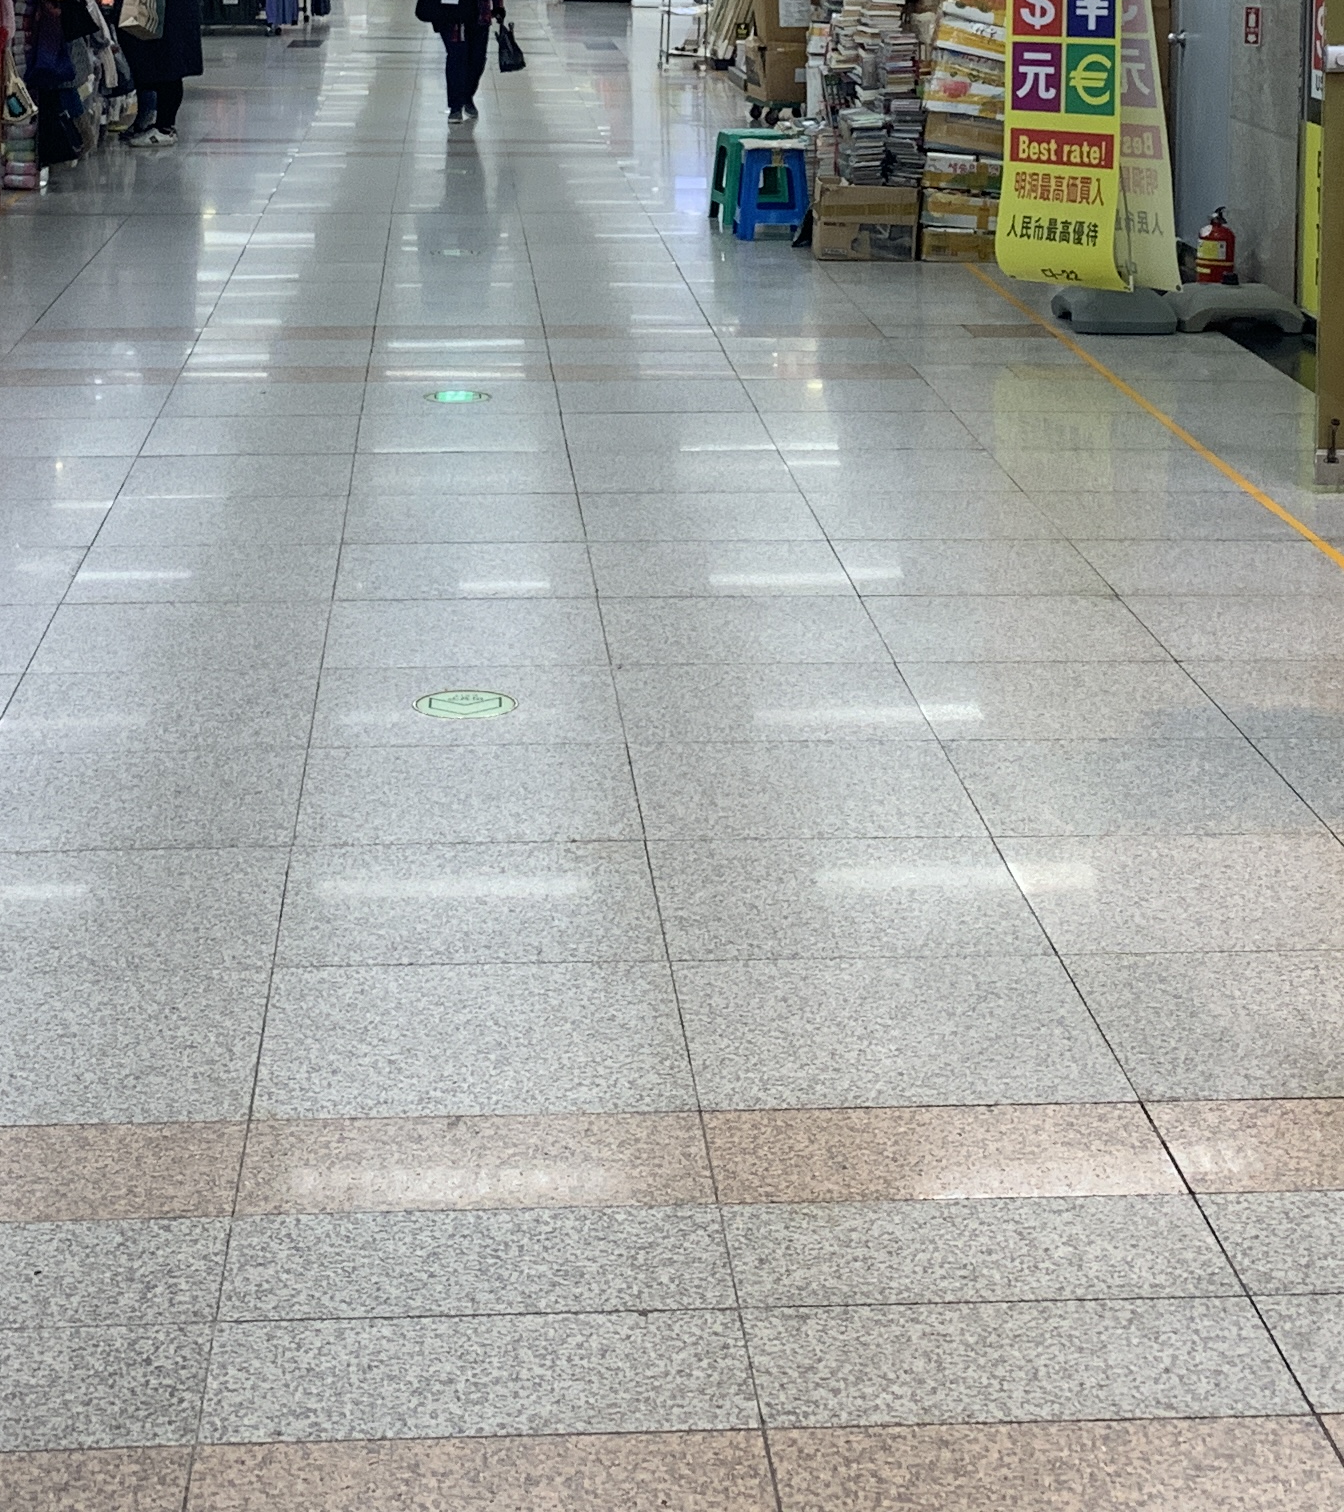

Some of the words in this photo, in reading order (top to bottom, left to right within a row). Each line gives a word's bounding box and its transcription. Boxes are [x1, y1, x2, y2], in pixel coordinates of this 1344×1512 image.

[1016, 52, 1057, 99] 元
[1018, 135, 1057, 161] Best
[1063, 141, 1106, 165] rate!
[1041, 267, 1082, 282] 다-22
